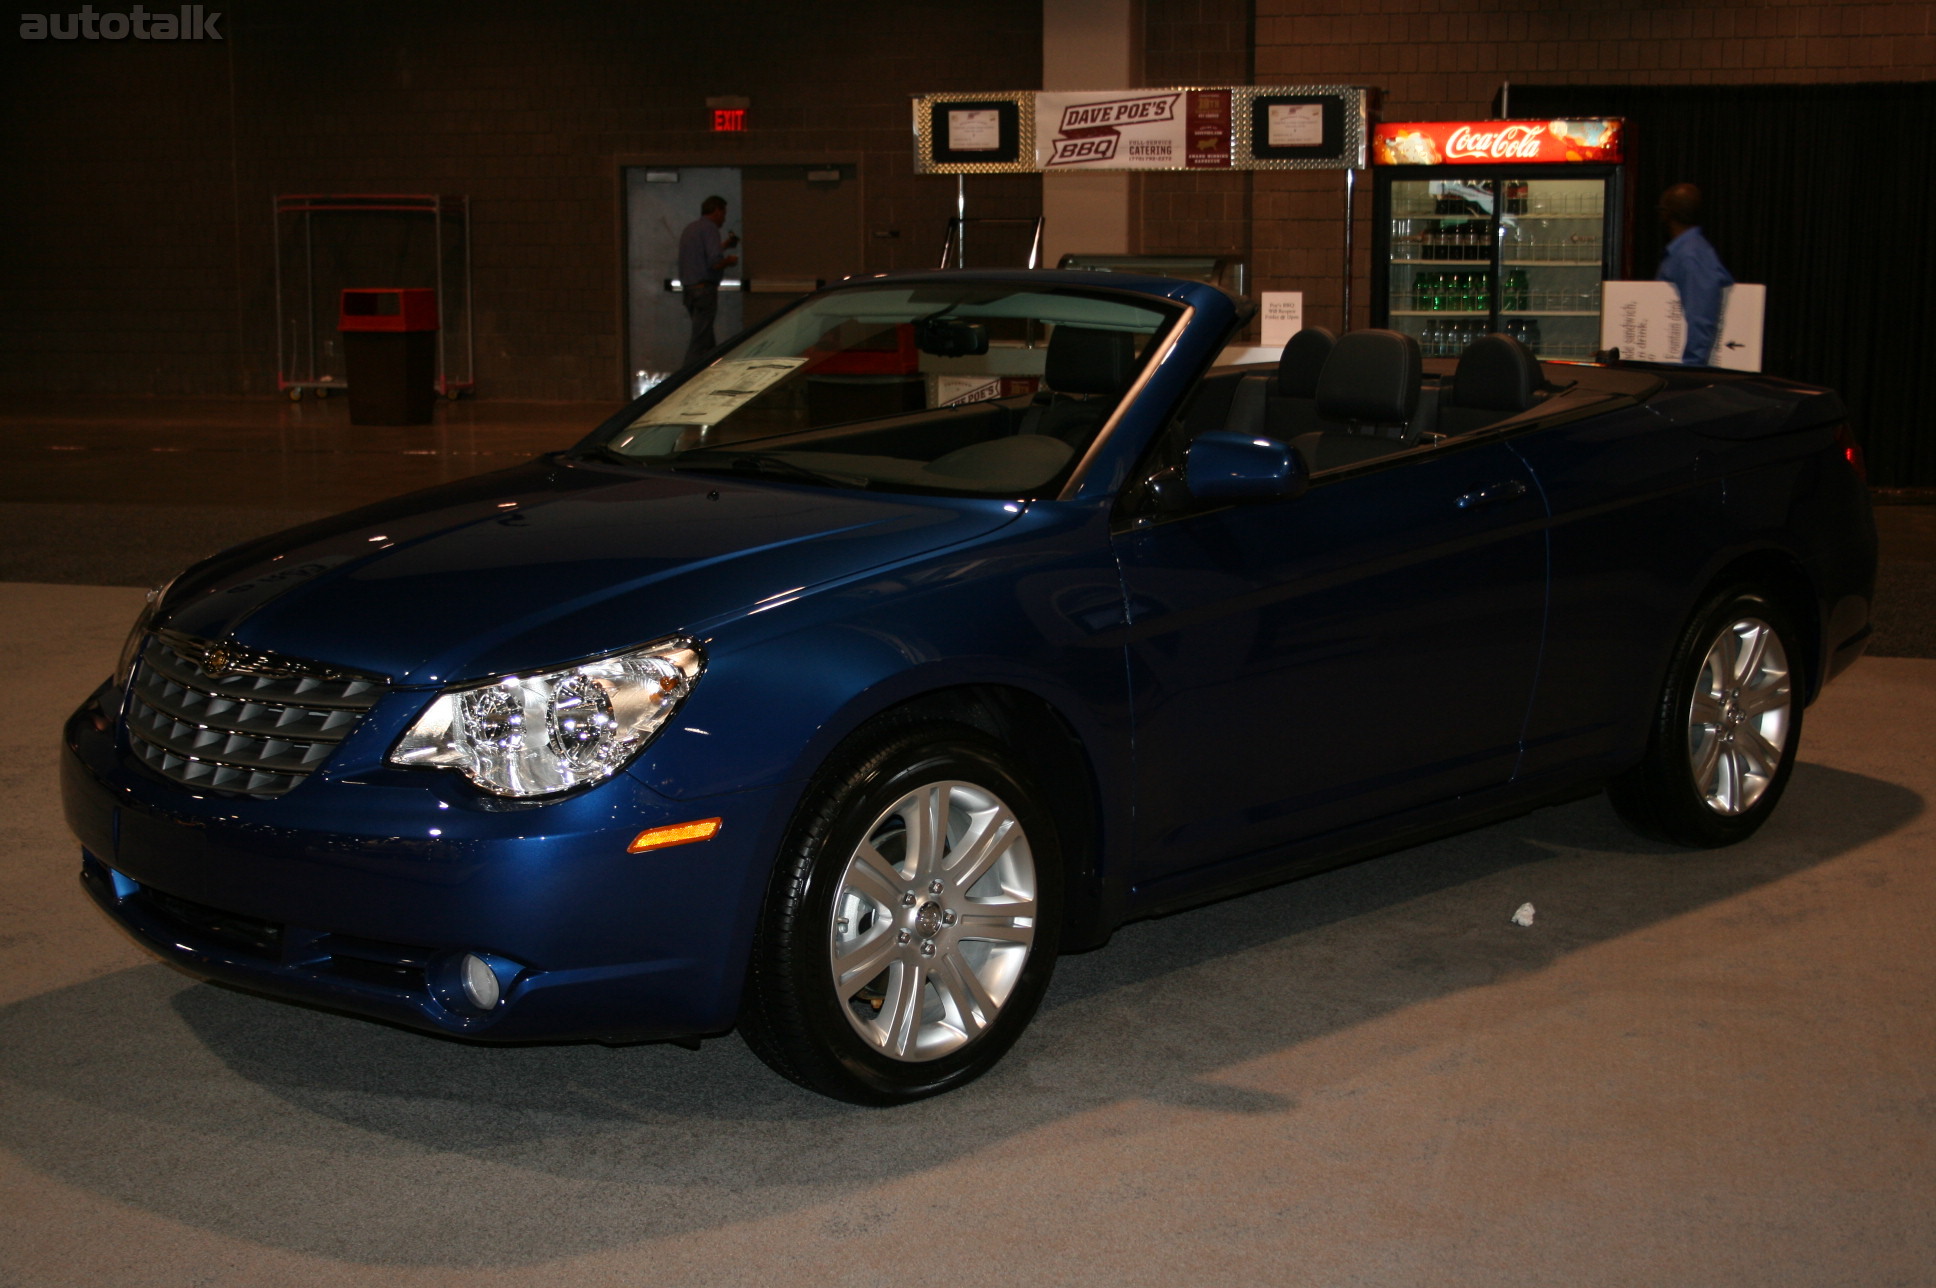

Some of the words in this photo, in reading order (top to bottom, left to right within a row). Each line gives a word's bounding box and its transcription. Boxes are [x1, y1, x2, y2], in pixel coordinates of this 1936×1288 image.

[715, 110, 744, 131] EXIT
[1066, 107, 1112, 127] DAVE
[1114, 100, 1168, 121] POE'S
[1059, 139, 1114, 159] BBQ
[1129, 146, 1172, 155] CATERING
[1445, 126, 1547, 158] Coca-Cola
